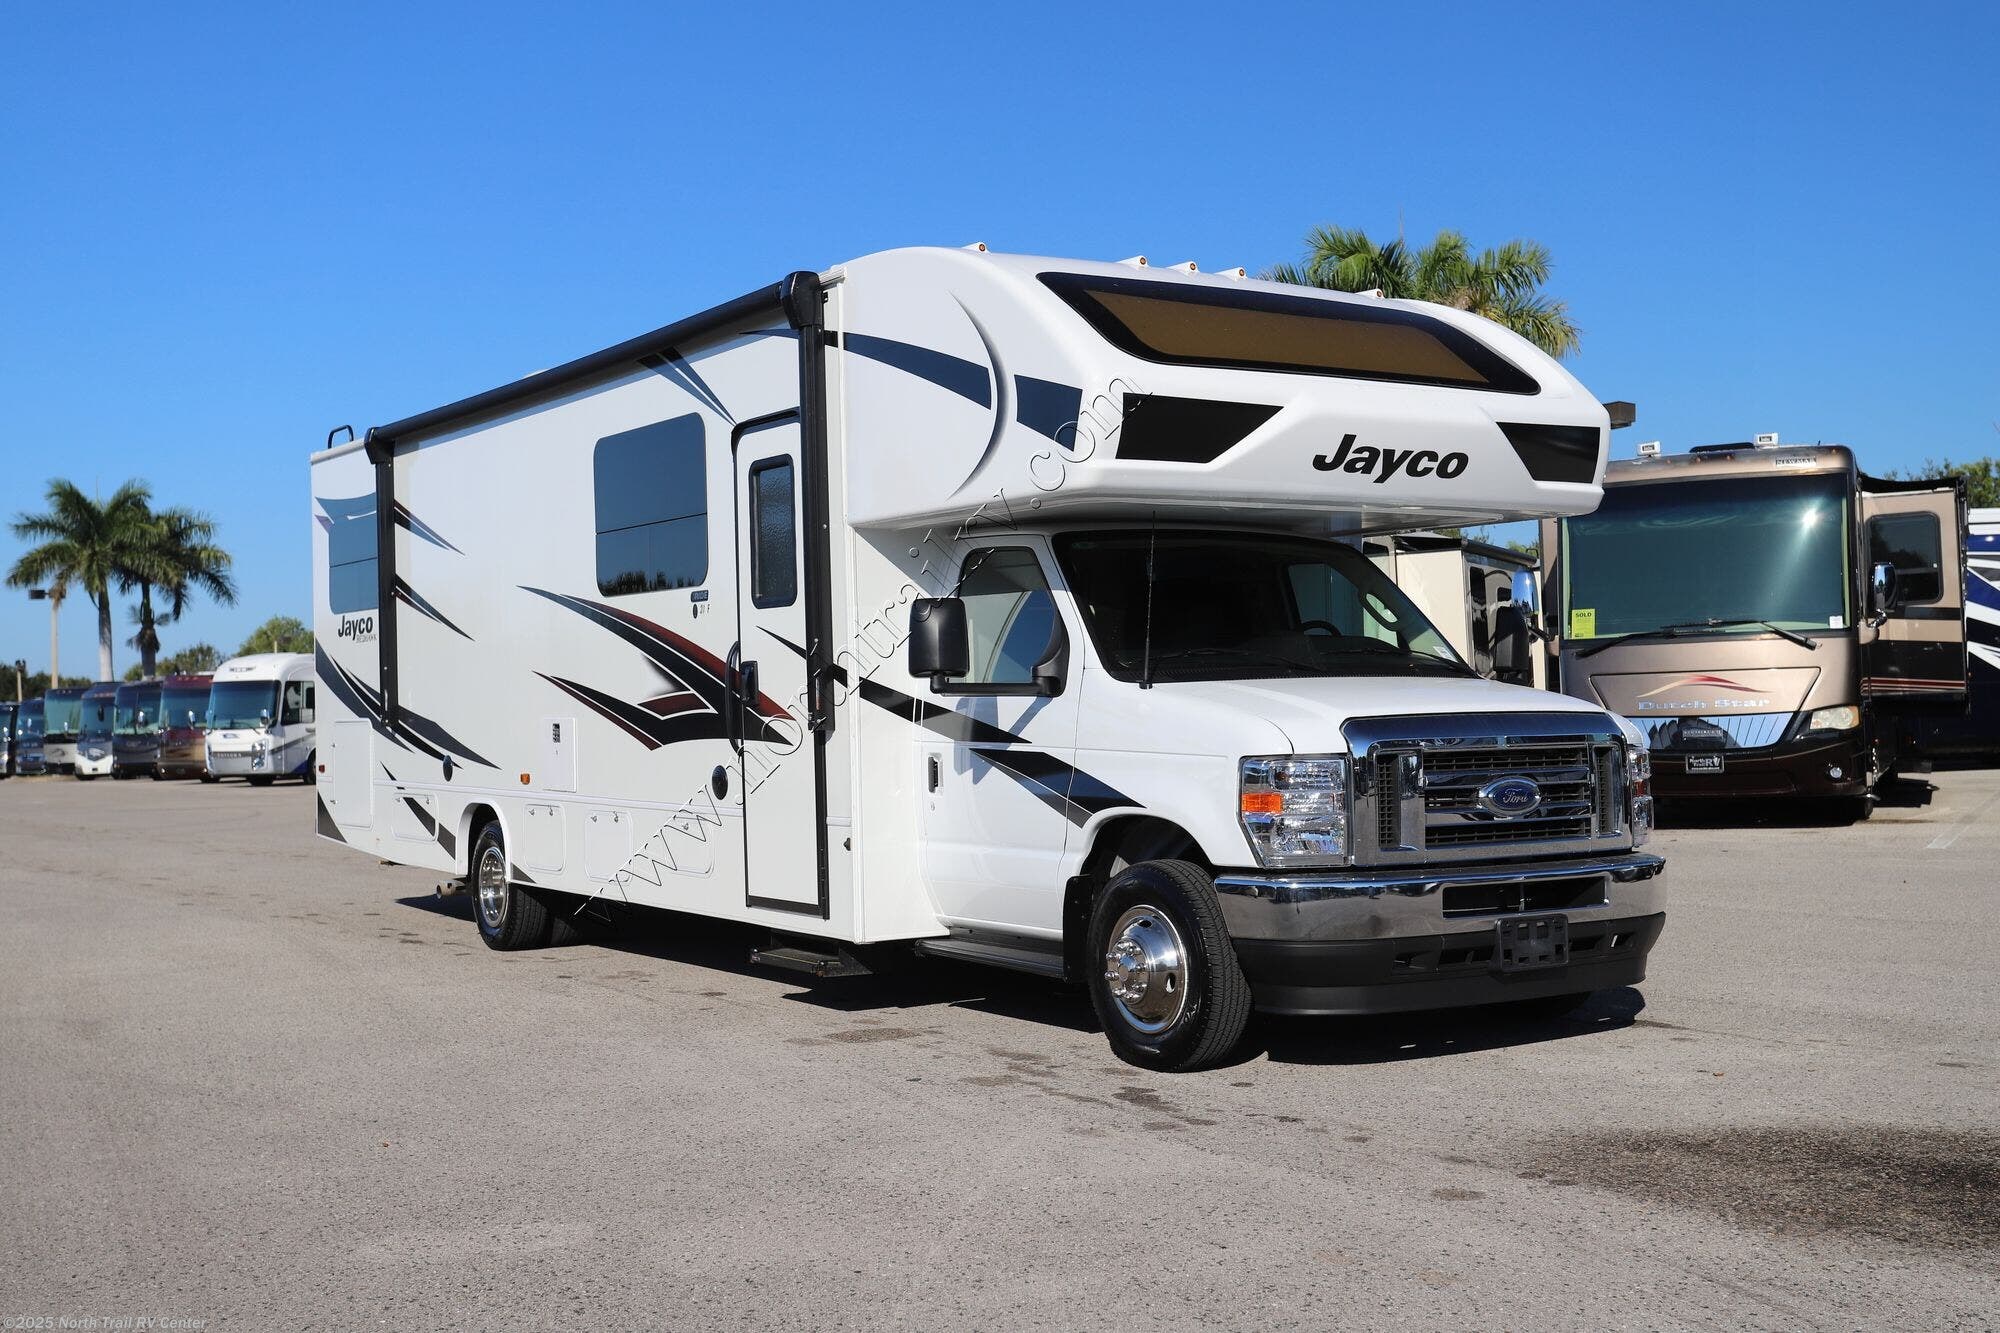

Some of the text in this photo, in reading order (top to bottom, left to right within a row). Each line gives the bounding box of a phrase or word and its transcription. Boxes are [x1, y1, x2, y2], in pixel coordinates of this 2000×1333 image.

[1312, 433, 1469, 484] Jayco
[337, 614, 374, 641] Jayco
[1638, 698, 1770, 710] Dutch Star
[1503, 788, 1529, 804] Ford
